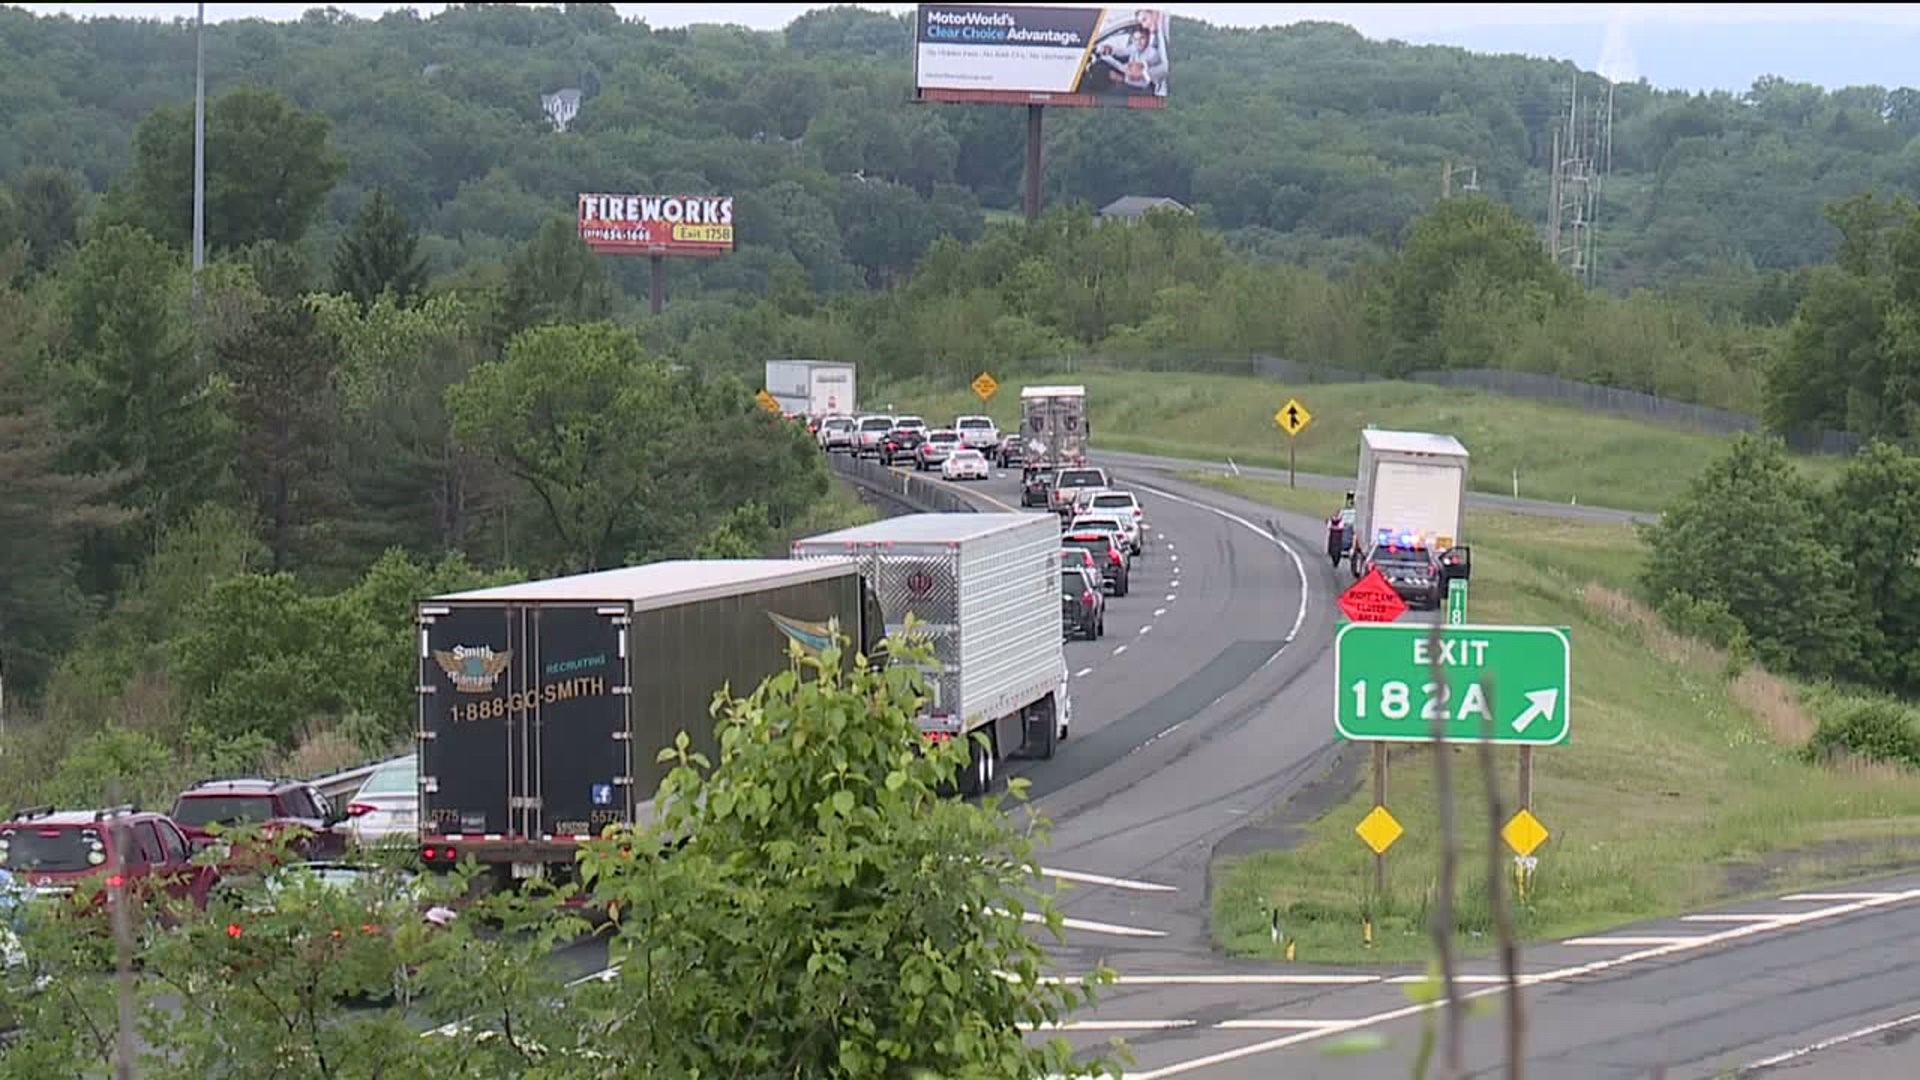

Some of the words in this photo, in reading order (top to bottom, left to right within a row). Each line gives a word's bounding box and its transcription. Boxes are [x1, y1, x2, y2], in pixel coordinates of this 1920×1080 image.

[927, 11, 1015, 26] MotorWorld's
[927, 26, 959, 38] Clear
[962, 27, 1004, 40] Choice
[1007, 28, 1081, 45] Advantage.
[585, 197, 733, 224] FIREWORKS
[680, 227, 701, 239] Exit
[706, 228, 731, 239] 175B
[452, 644, 494, 661] Smith
[1413, 638, 1489, 666] EXIT
[1352, 679, 1493, 721] 182A
